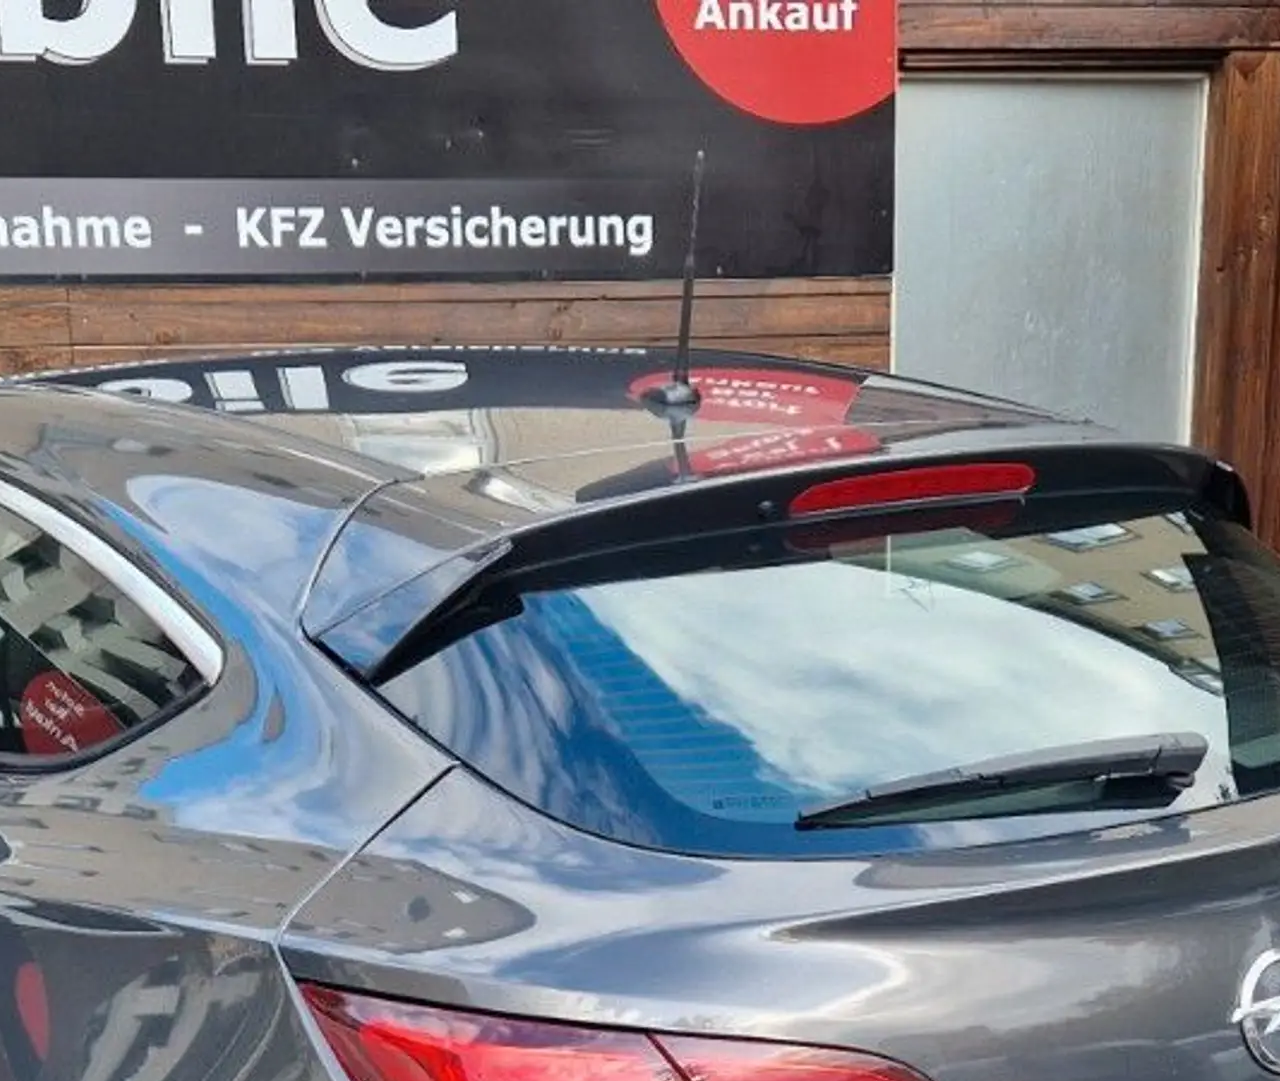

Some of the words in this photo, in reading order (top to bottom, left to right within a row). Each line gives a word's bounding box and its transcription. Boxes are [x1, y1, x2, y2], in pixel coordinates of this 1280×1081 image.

[694, 0, 858, 31] Ankauf
[184, 225, 203, 235] -
[236, 207, 327, 248] KFZ
[341, 206, 654, 255] Versicherung
